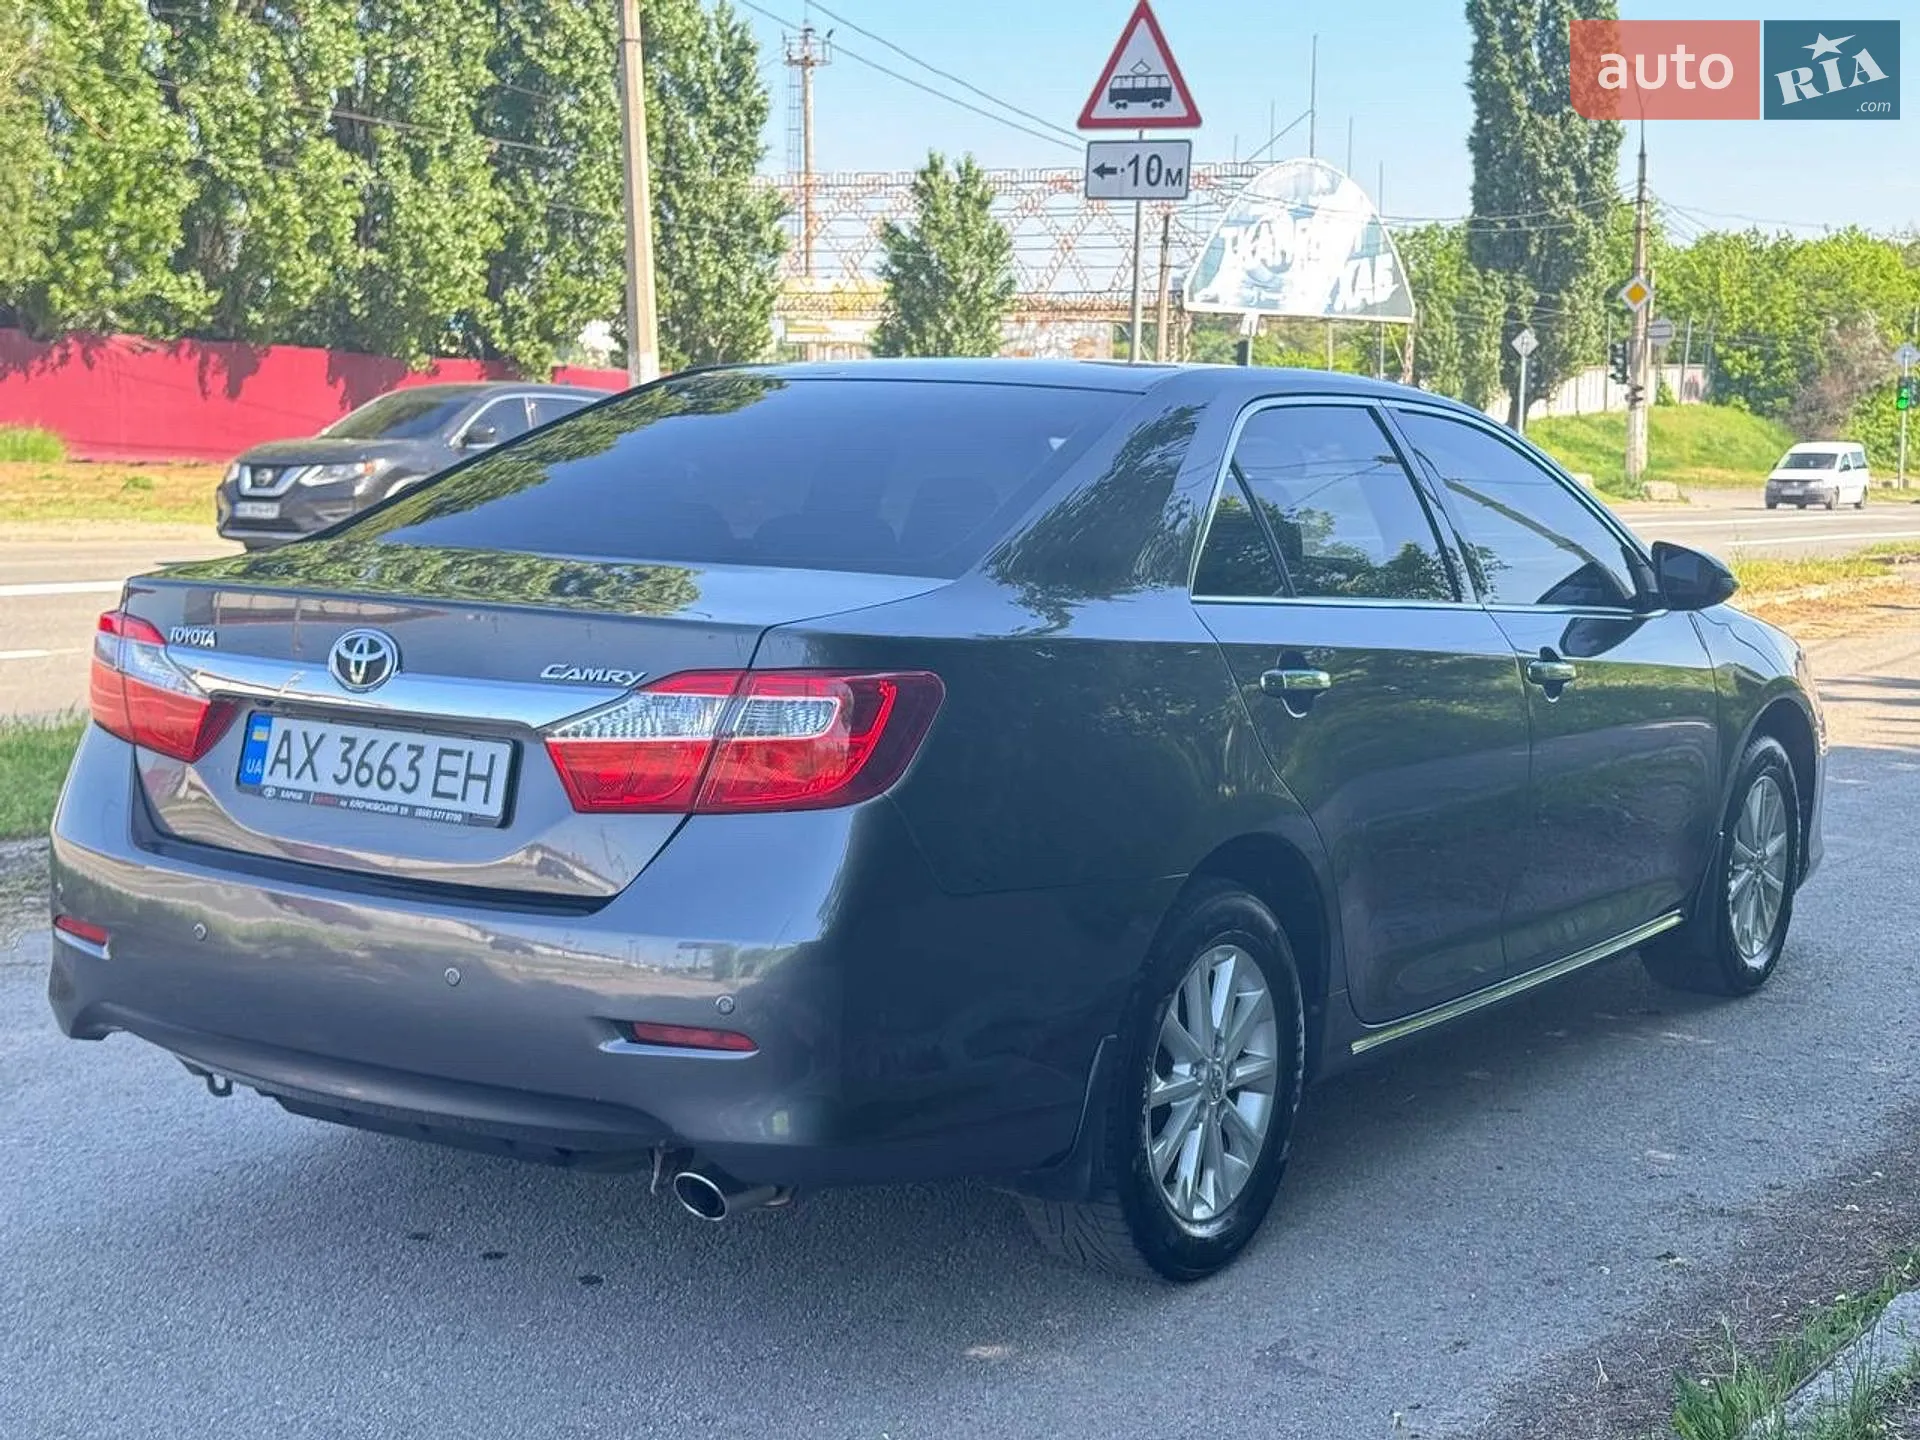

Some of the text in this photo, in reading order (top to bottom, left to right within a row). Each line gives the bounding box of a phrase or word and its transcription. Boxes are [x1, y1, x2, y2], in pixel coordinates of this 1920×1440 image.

[169, 626, 217, 648] TOYOTA
[540, 664, 648, 686] CAMRY
[246, 758, 263, 776] UA
[268, 729, 497, 805] AX 3663 EH
